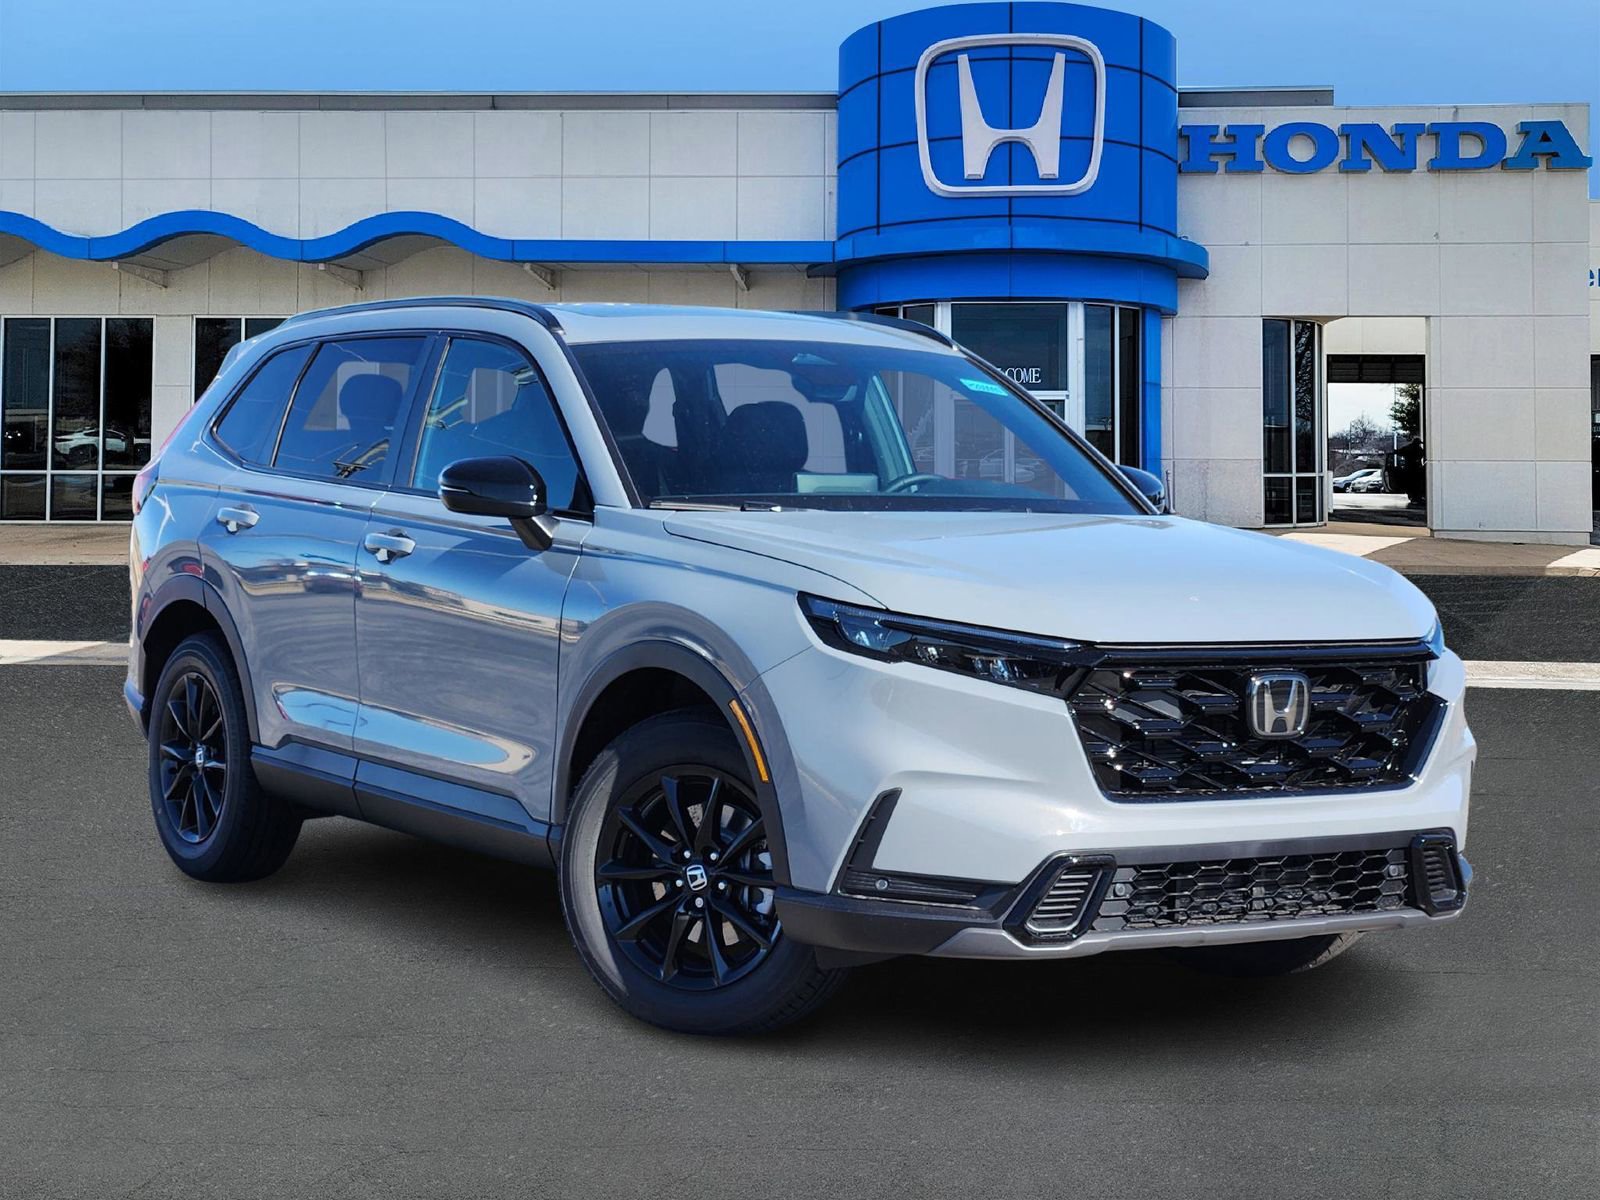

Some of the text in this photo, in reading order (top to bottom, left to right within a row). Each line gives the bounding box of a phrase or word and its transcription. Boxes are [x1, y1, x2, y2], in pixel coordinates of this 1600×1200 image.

[957, 52, 1066, 179] H
[1179, 120, 1593, 174] HONDA
[997, 367, 1042, 384] COME
